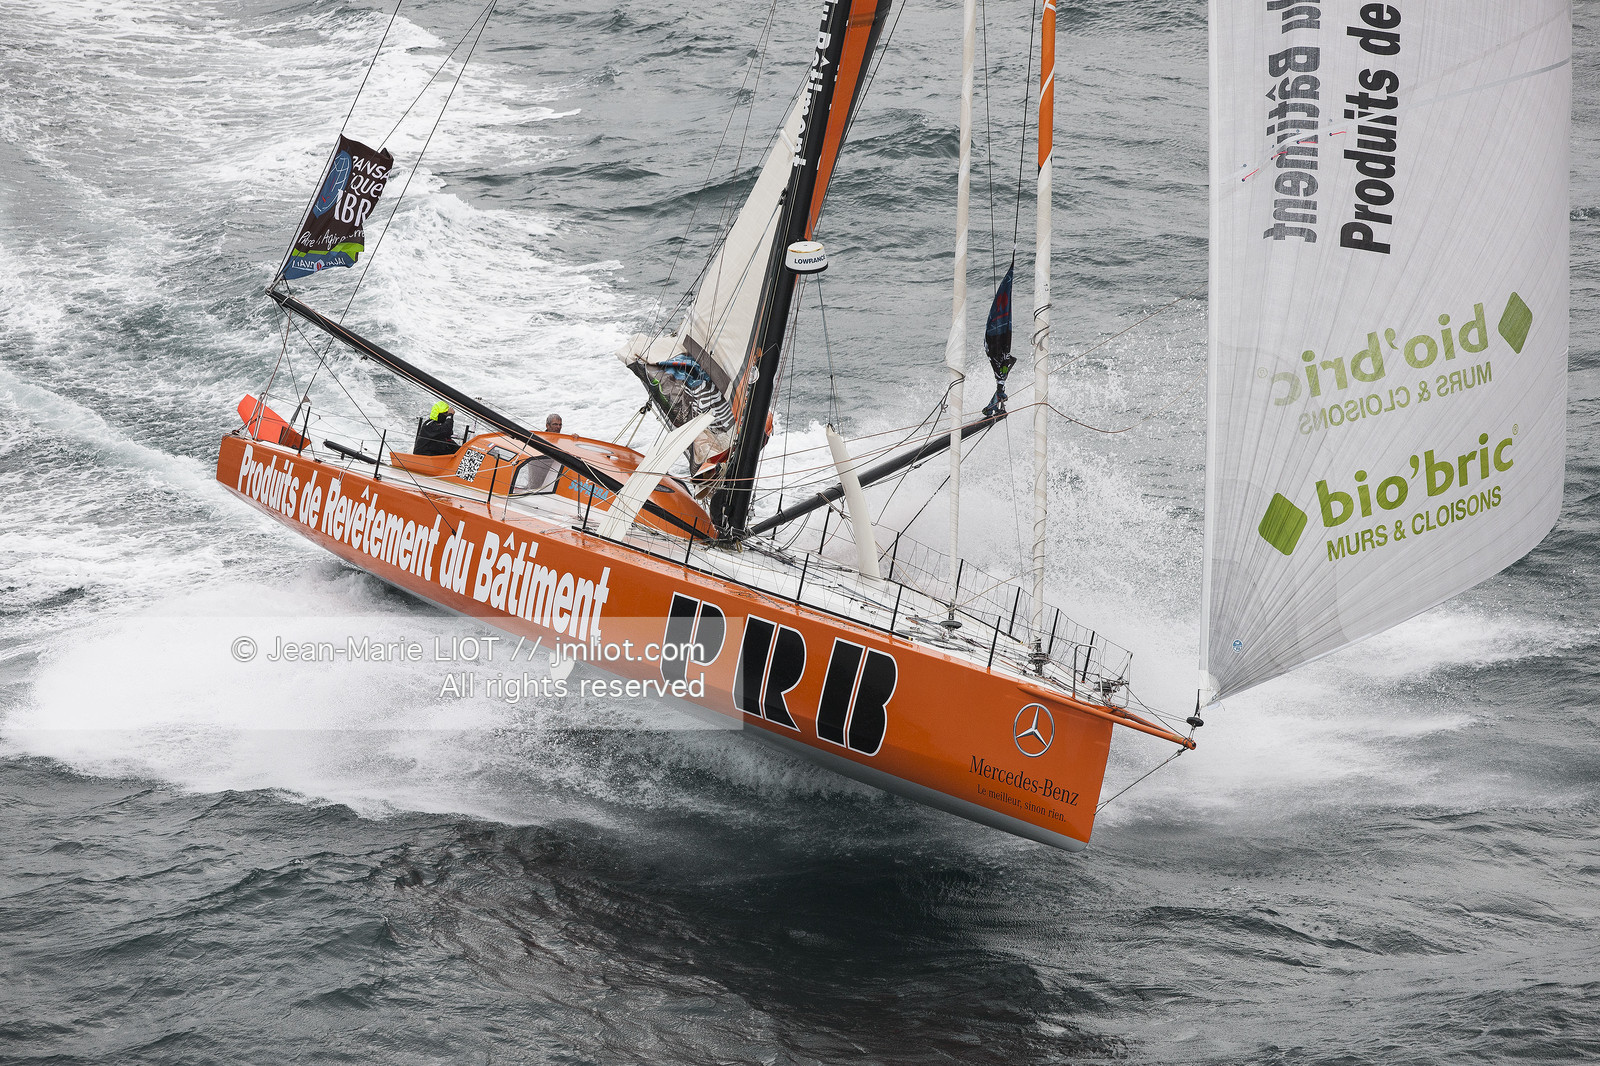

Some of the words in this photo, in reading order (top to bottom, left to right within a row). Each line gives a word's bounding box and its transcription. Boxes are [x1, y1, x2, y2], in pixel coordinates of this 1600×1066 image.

[1346, 3, 1402, 56] de
[1340, 68, 1400, 254] Produits
[1315, 432, 1515, 528] bio'bric
[236, 443, 299, 517] Produits
[298, 470, 324, 526] de
[321, 476, 442, 581] Revêtement
[439, 519, 475, 595] du
[473, 529, 611, 645] Bâtiment
[1326, 525, 1389, 562] MURS
[1393, 520, 1407, 542] &
[1411, 485, 1502, 535] CLOISONS
[659, 591, 899, 757] PRB
[968, 754, 1080, 807] Mercedes-Benz
[977, 783, 987, 795] Le
[988, 789, 1023, 809] meilleur,
[1024, 801, 1046, 816] sinon
[1047, 808, 1067, 823] rien.
